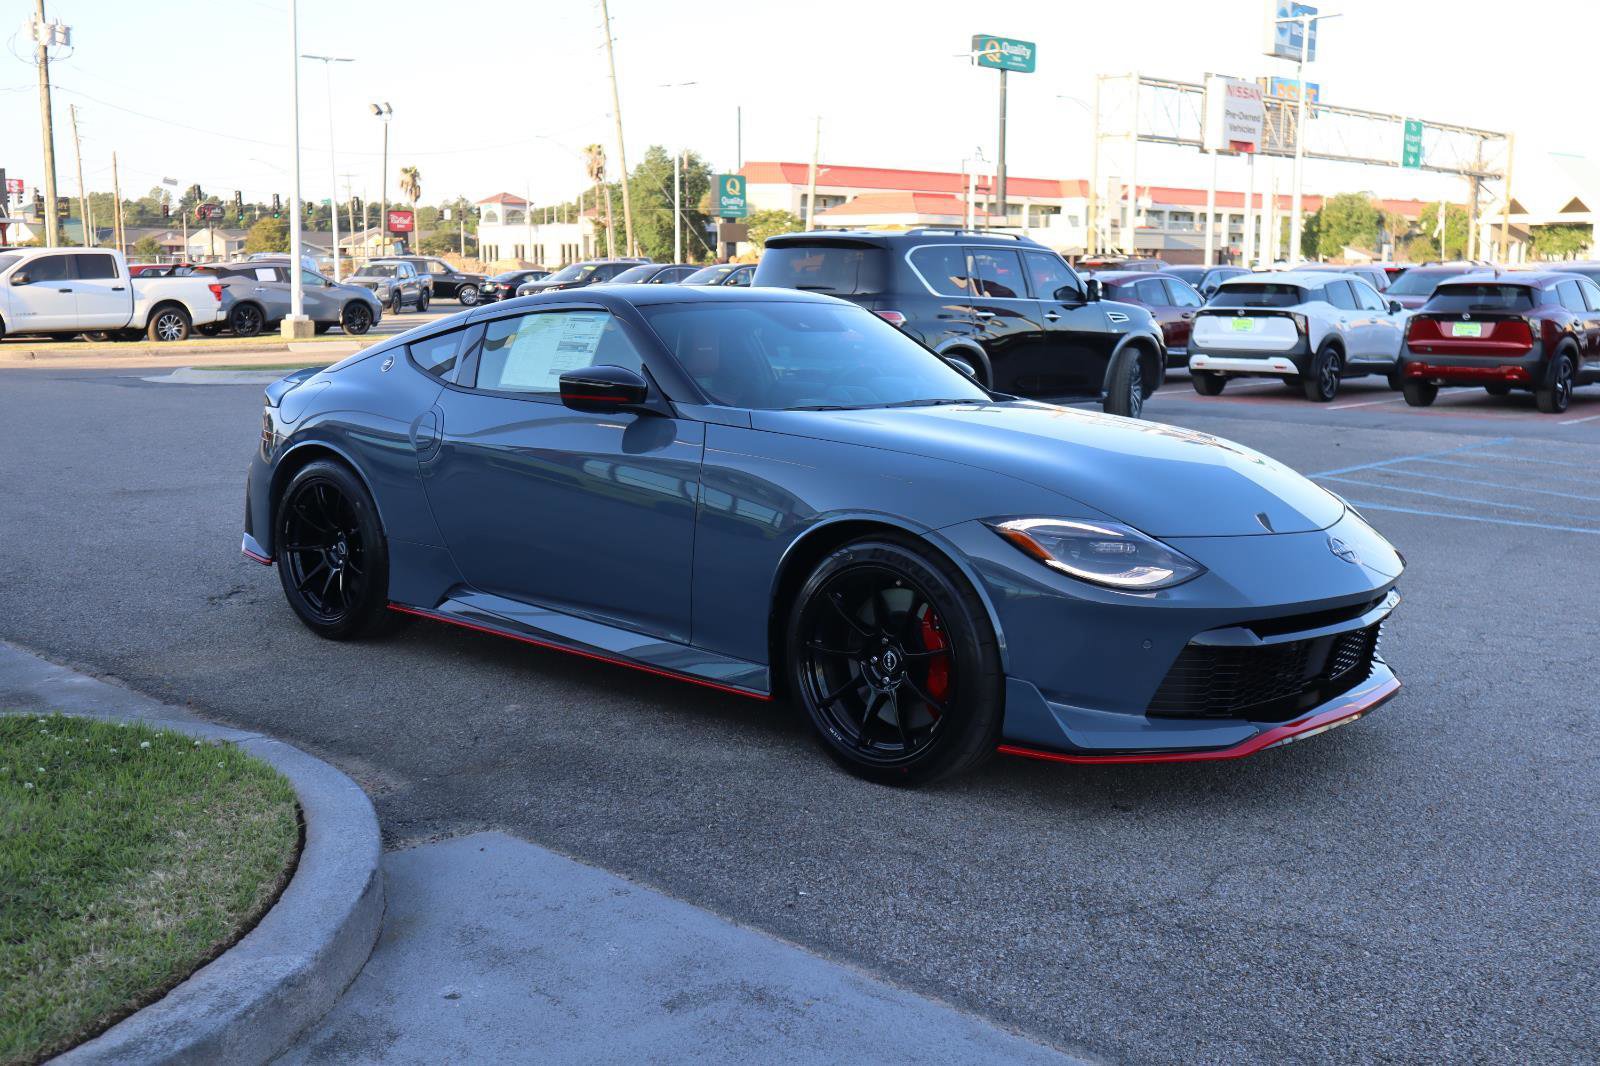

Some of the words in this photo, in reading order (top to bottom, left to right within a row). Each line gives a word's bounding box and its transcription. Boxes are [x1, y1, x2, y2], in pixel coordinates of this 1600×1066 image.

[1002, 41, 1031, 59] Quality
[1227, 84, 1262, 100] NISSAN
[1225, 109, 1260, 122] Pre-Owned
[1229, 124, 1256, 135] Vehicles
[726, 177, 741, 195] Q
[721, 196, 744, 207] Quality
